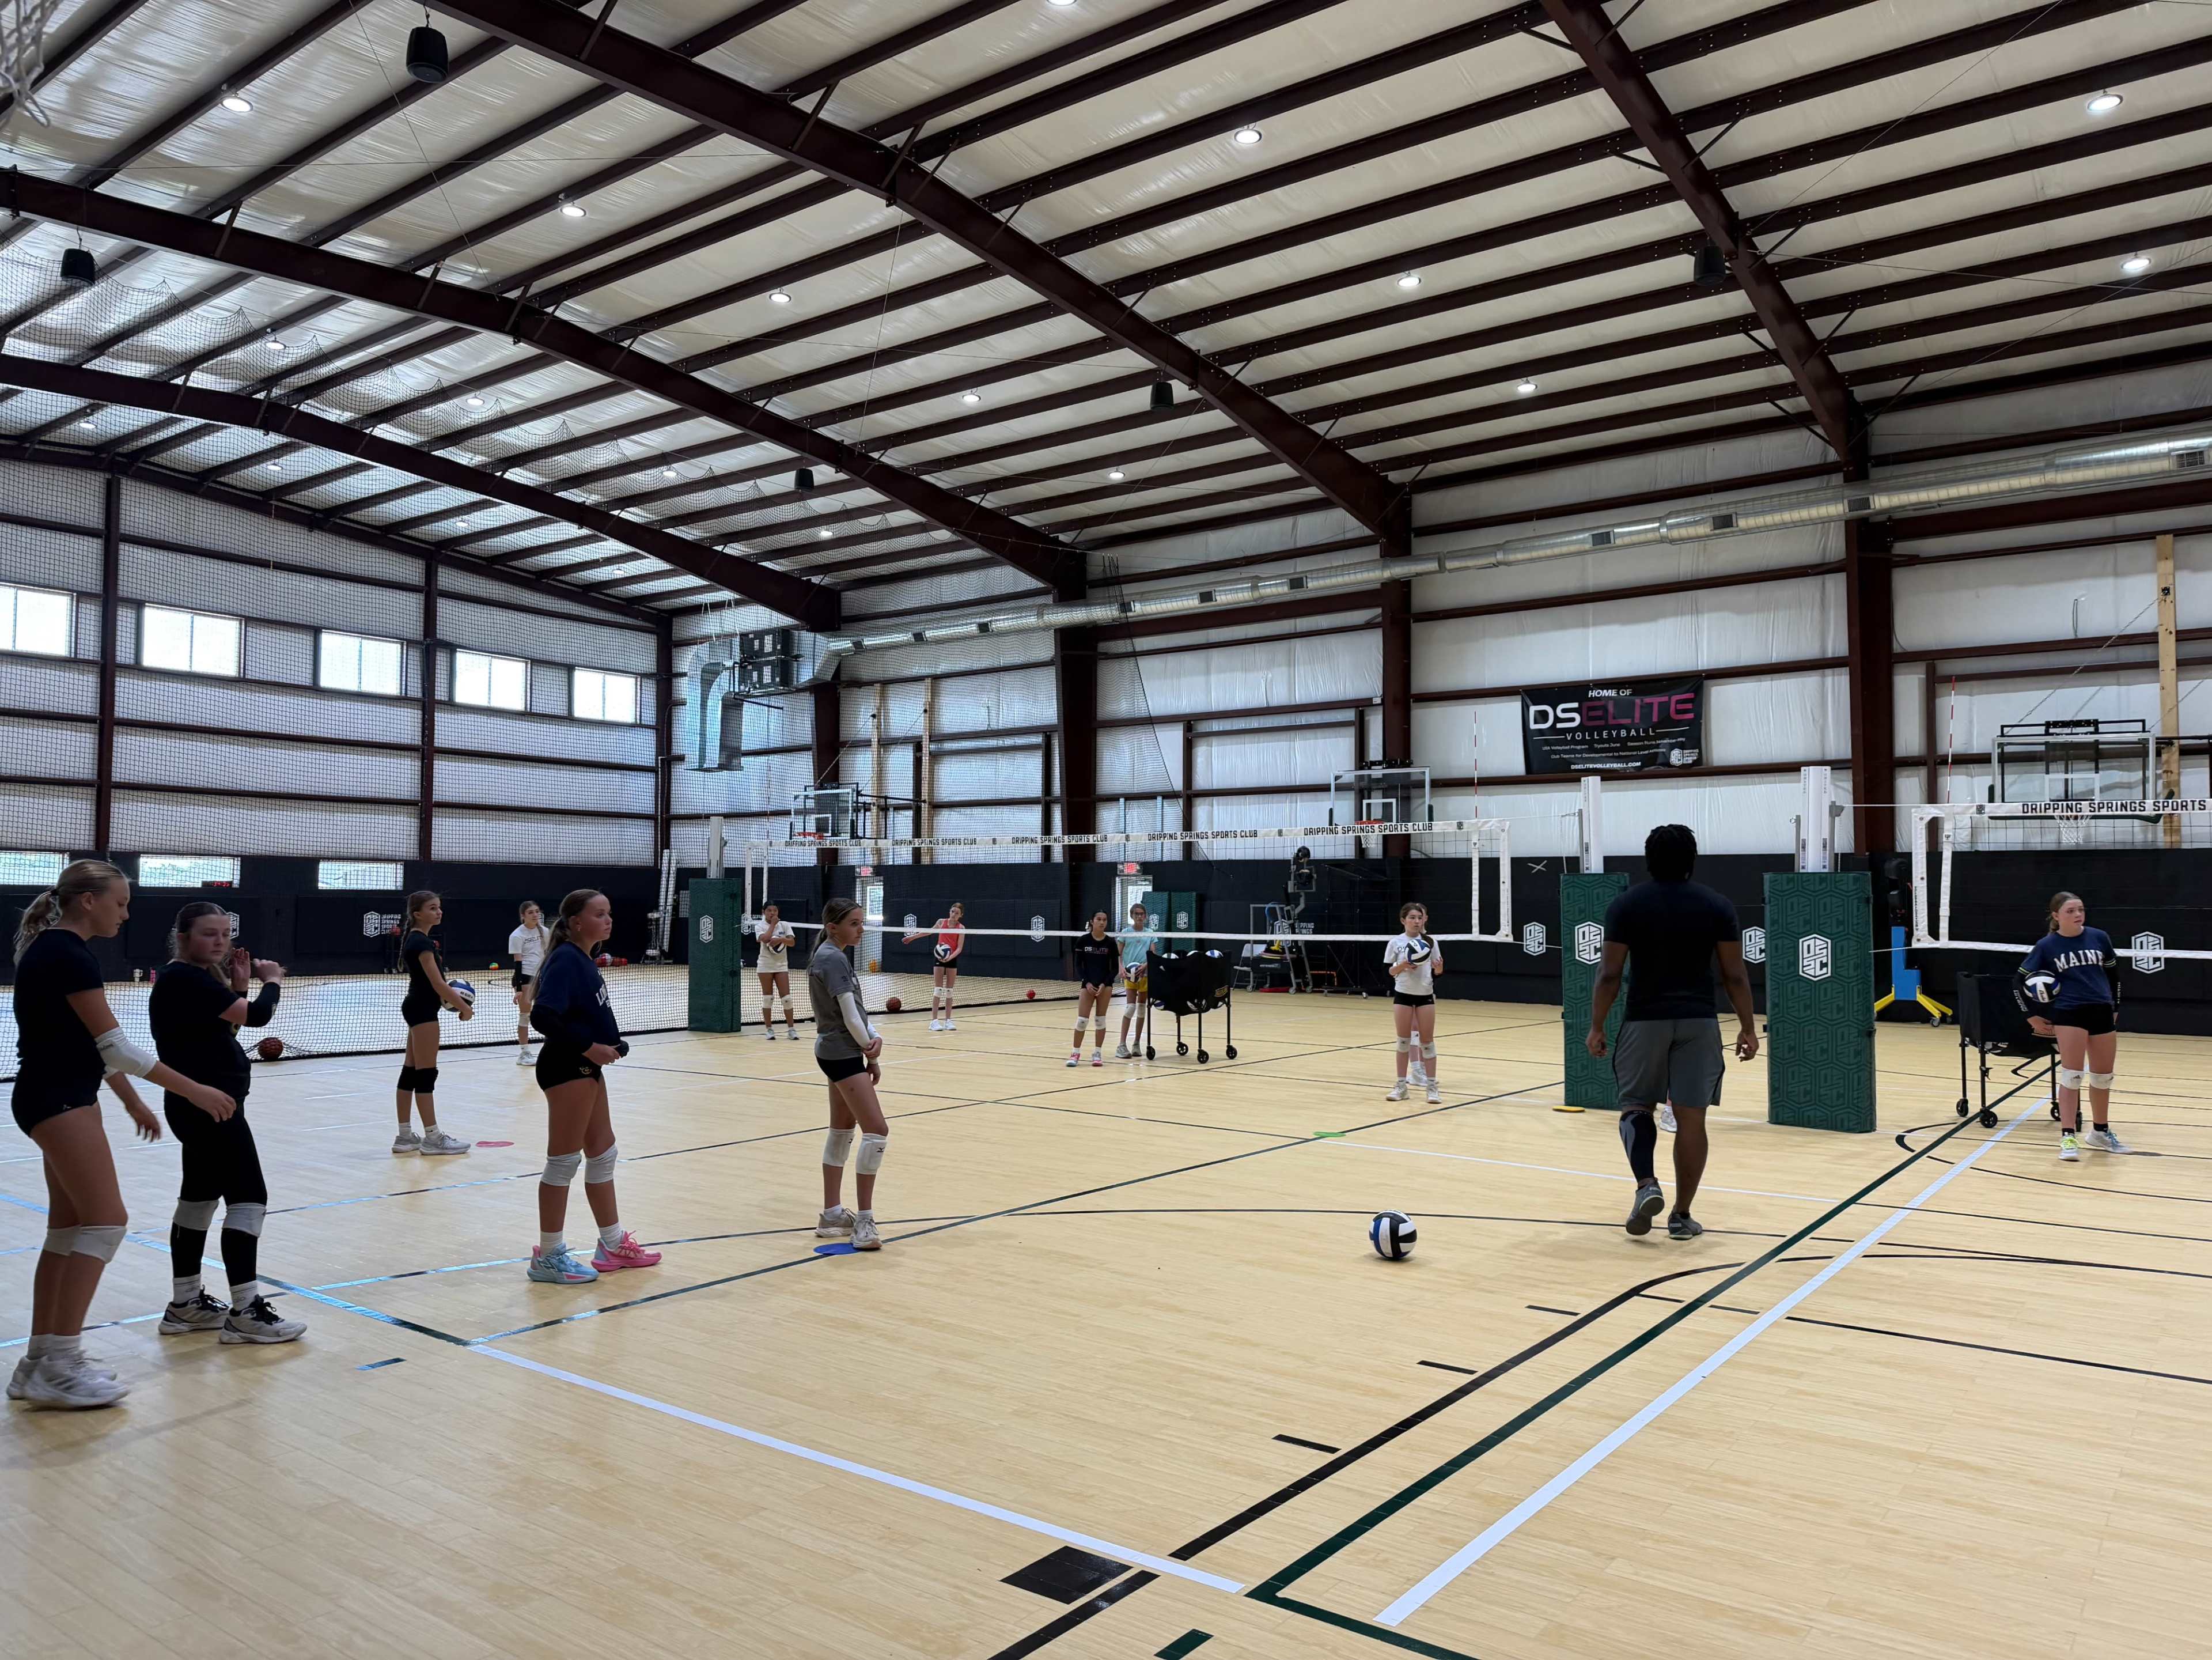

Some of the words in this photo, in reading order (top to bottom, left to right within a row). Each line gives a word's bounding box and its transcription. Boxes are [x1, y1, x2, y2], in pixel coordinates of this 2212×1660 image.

[1588, 689, 1618, 697] HOME
[1566, 728, 1655, 740] VOLLEYBALL
[1570, 761, 1641, 770] DSELITEVOLLEYBALL.COM
[2022, 802, 2082, 814] DRIPPING
[2089, 800, 2146, 812] SPRINGS
[2153, 799, 2206, 811] SPORTS
[1304, 825, 1338, 836] DRIPPING
[1342, 825, 1375, 834] SPRINGS
[1378, 823, 1409, 833] SPORTS
[1412, 822, 1433, 831] CLUB
[1067, 835, 1090, 843] SPORTS
[1148, 832, 1177, 841] DRIPPING
[1180, 831, 1209, 840] SPRINGS
[1211, 830, 1237, 839] SPORTS
[1240, 830, 1257, 838] CLUB
